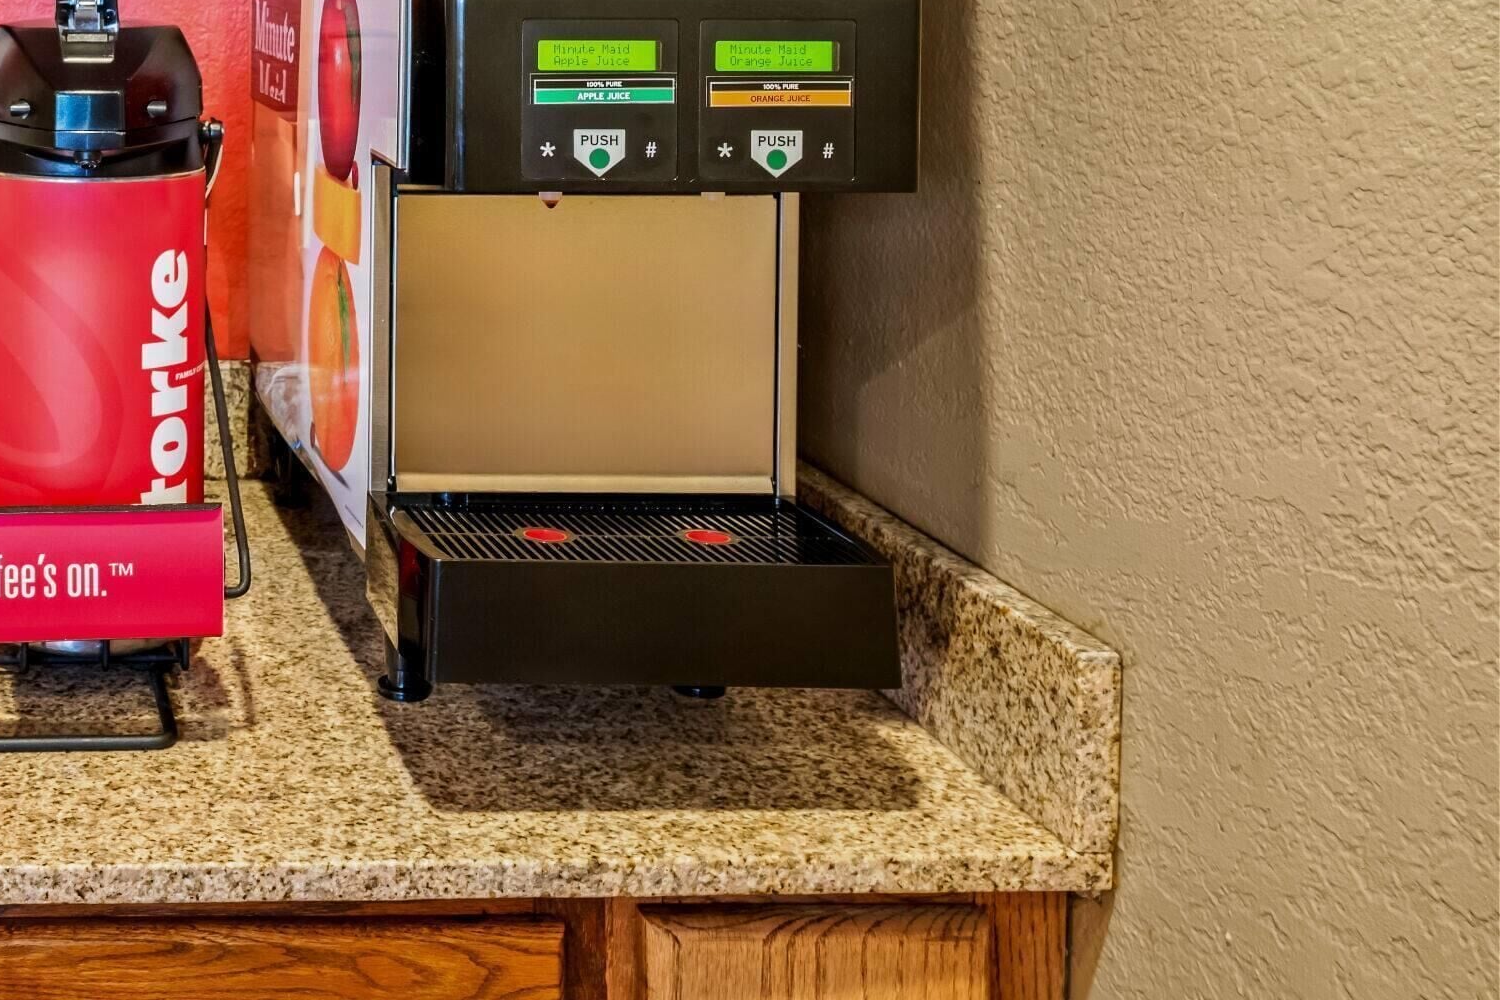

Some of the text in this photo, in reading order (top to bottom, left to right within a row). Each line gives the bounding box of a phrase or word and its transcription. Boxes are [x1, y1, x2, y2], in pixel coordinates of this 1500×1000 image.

[255, 0, 295, 64] Minute
[553, 44, 630, 55] Minute Maid
[730, 45, 806, 55] Minute Maid
[553, 56, 630, 67] Apple Juice
[730, 56, 813, 68] Orange Juice
[260, 59, 287, 104] Maid
[577, 92, 631, 100] APPLE JUICE
[580, 135, 619, 146] PUSH
[758, 135, 796, 147] PUSH
[141, 249, 189, 504] torke
